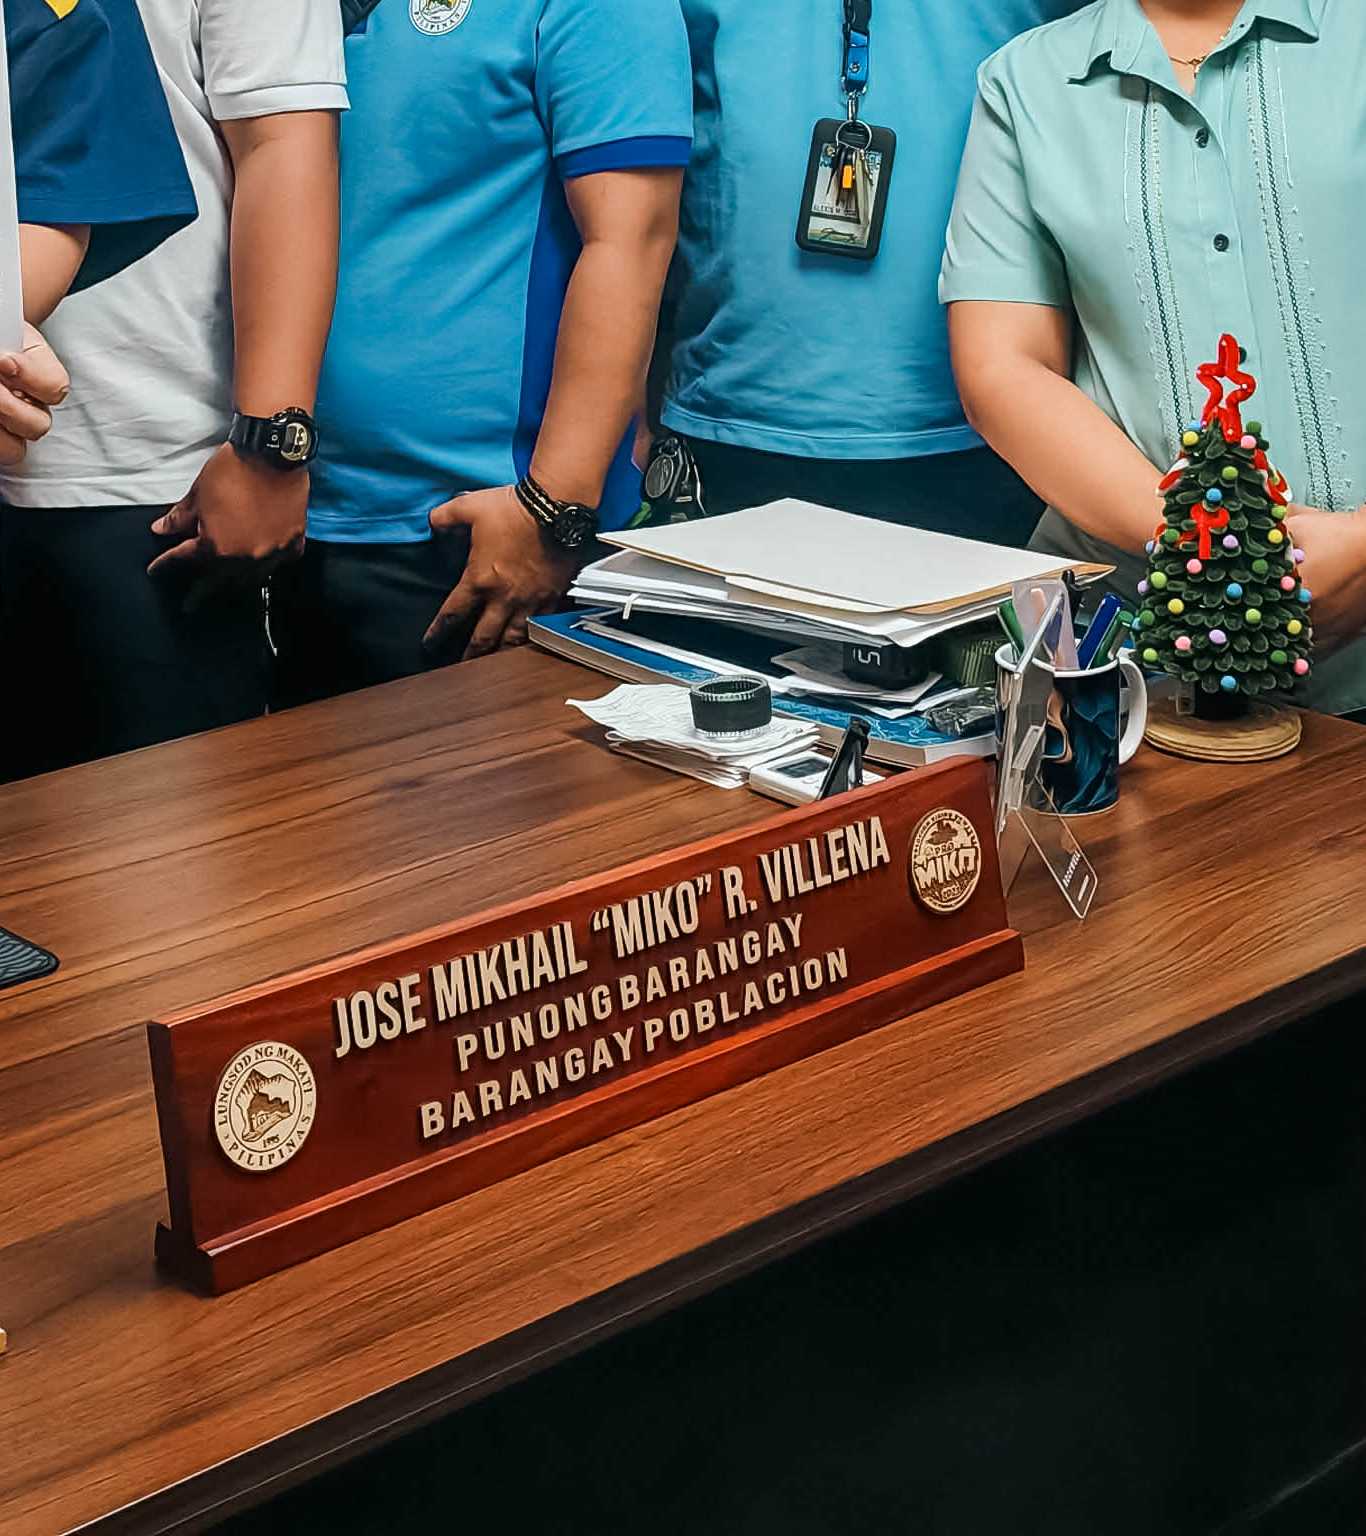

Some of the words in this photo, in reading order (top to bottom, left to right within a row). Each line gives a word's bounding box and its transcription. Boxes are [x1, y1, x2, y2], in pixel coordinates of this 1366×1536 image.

[914, 848, 976, 889] MIKO
[334, 974, 428, 1059] JOSE
[432, 921, 589, 1023] MIKHAIL
[721, 866, 759, 919] R.
[758, 816, 892, 905] VILLENA
[457, 984, 613, 1072] PUNONG
[619, 913, 805, 1011] BARANGAY
[218, 1054, 252, 1126] LUNGSOD
[254, 1045, 274, 1060] NG
[276, 1047, 314, 1094] MAKATI
[419, 1027, 635, 1140] BARANGAY
[644, 947, 850, 1053] POBLACION
[228, 1114, 311, 1167] PILIPINAS
